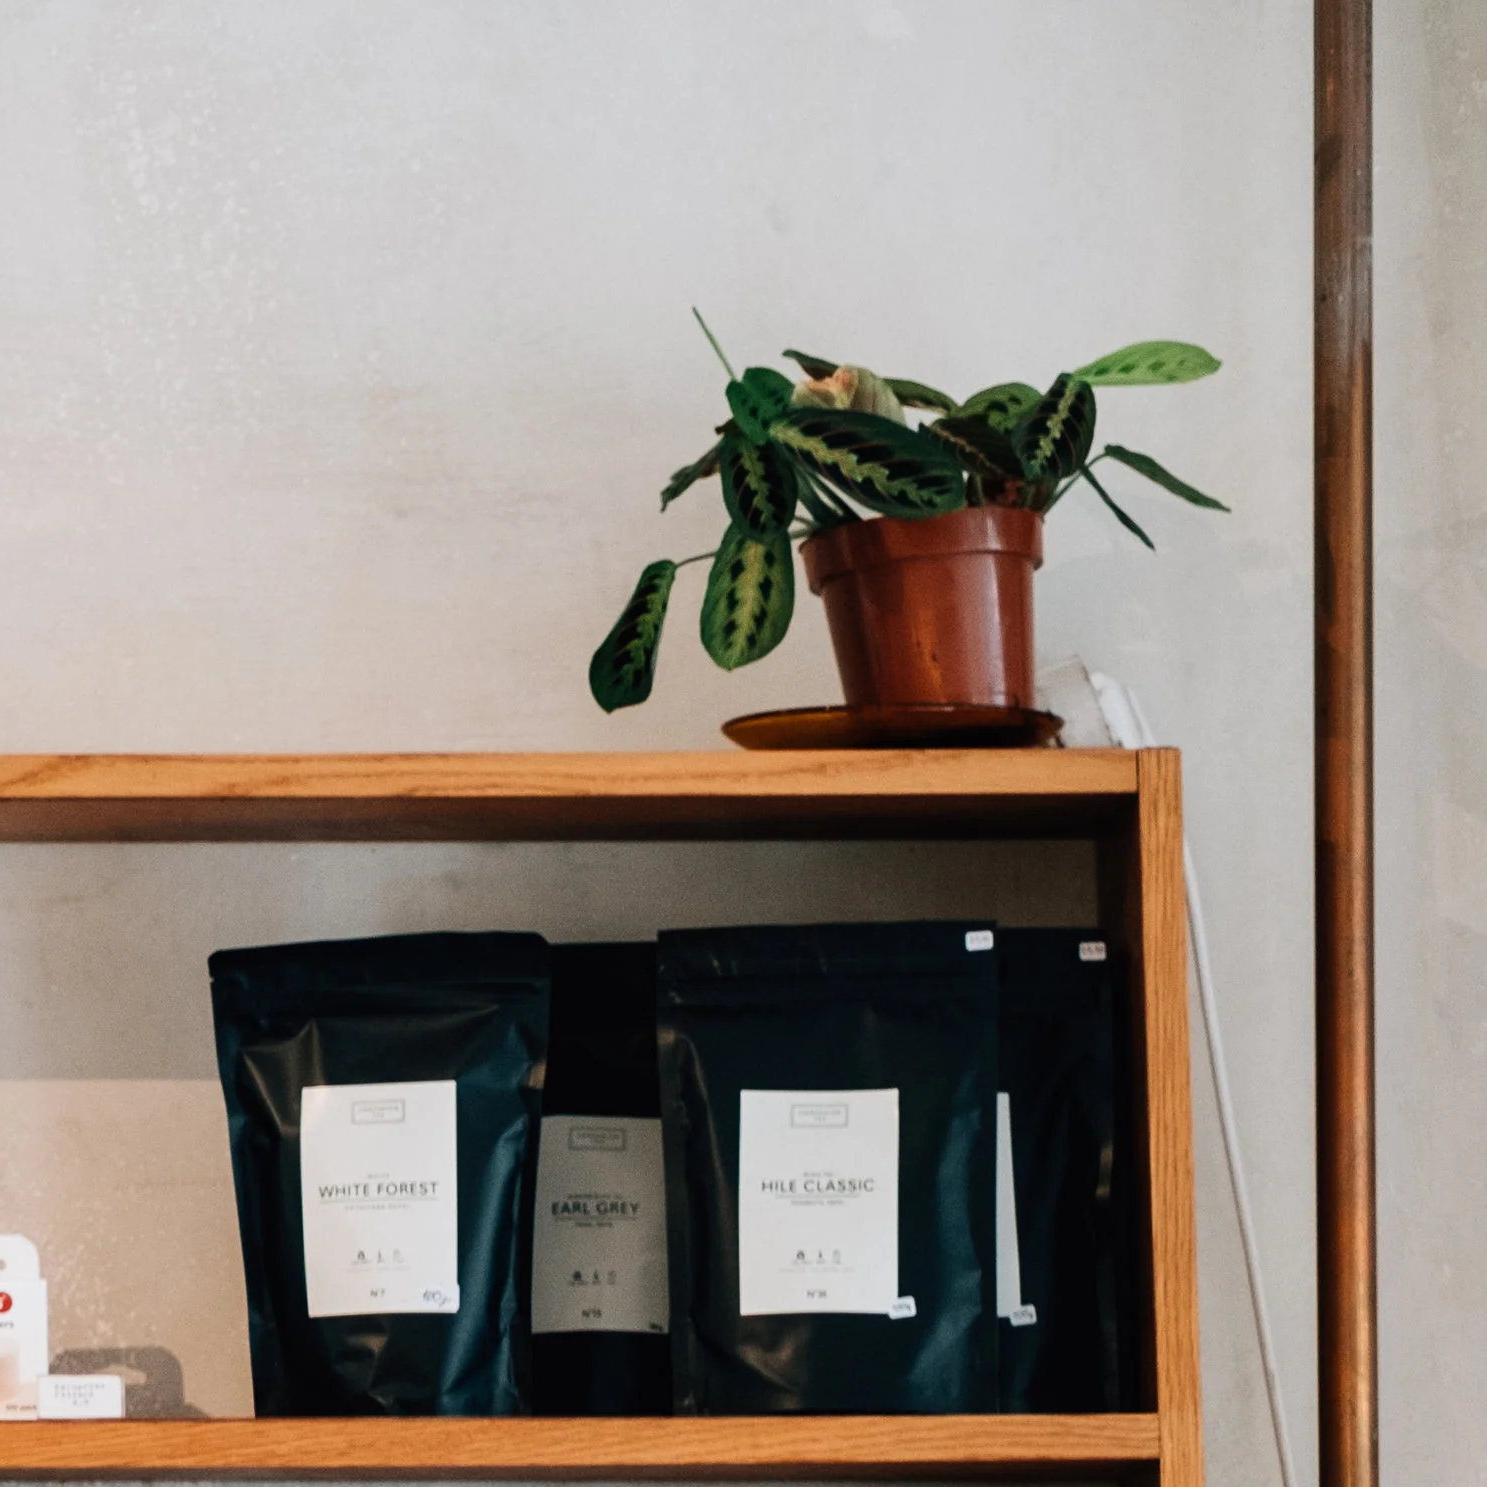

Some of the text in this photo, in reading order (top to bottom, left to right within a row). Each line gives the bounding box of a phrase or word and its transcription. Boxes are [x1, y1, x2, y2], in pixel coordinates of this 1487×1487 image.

[318, 1181, 439, 1198] WHITE FOREST
[761, 1178, 875, 1193] HILE CLASSIC
[551, 1200, 640, 1216] EARL GREY
